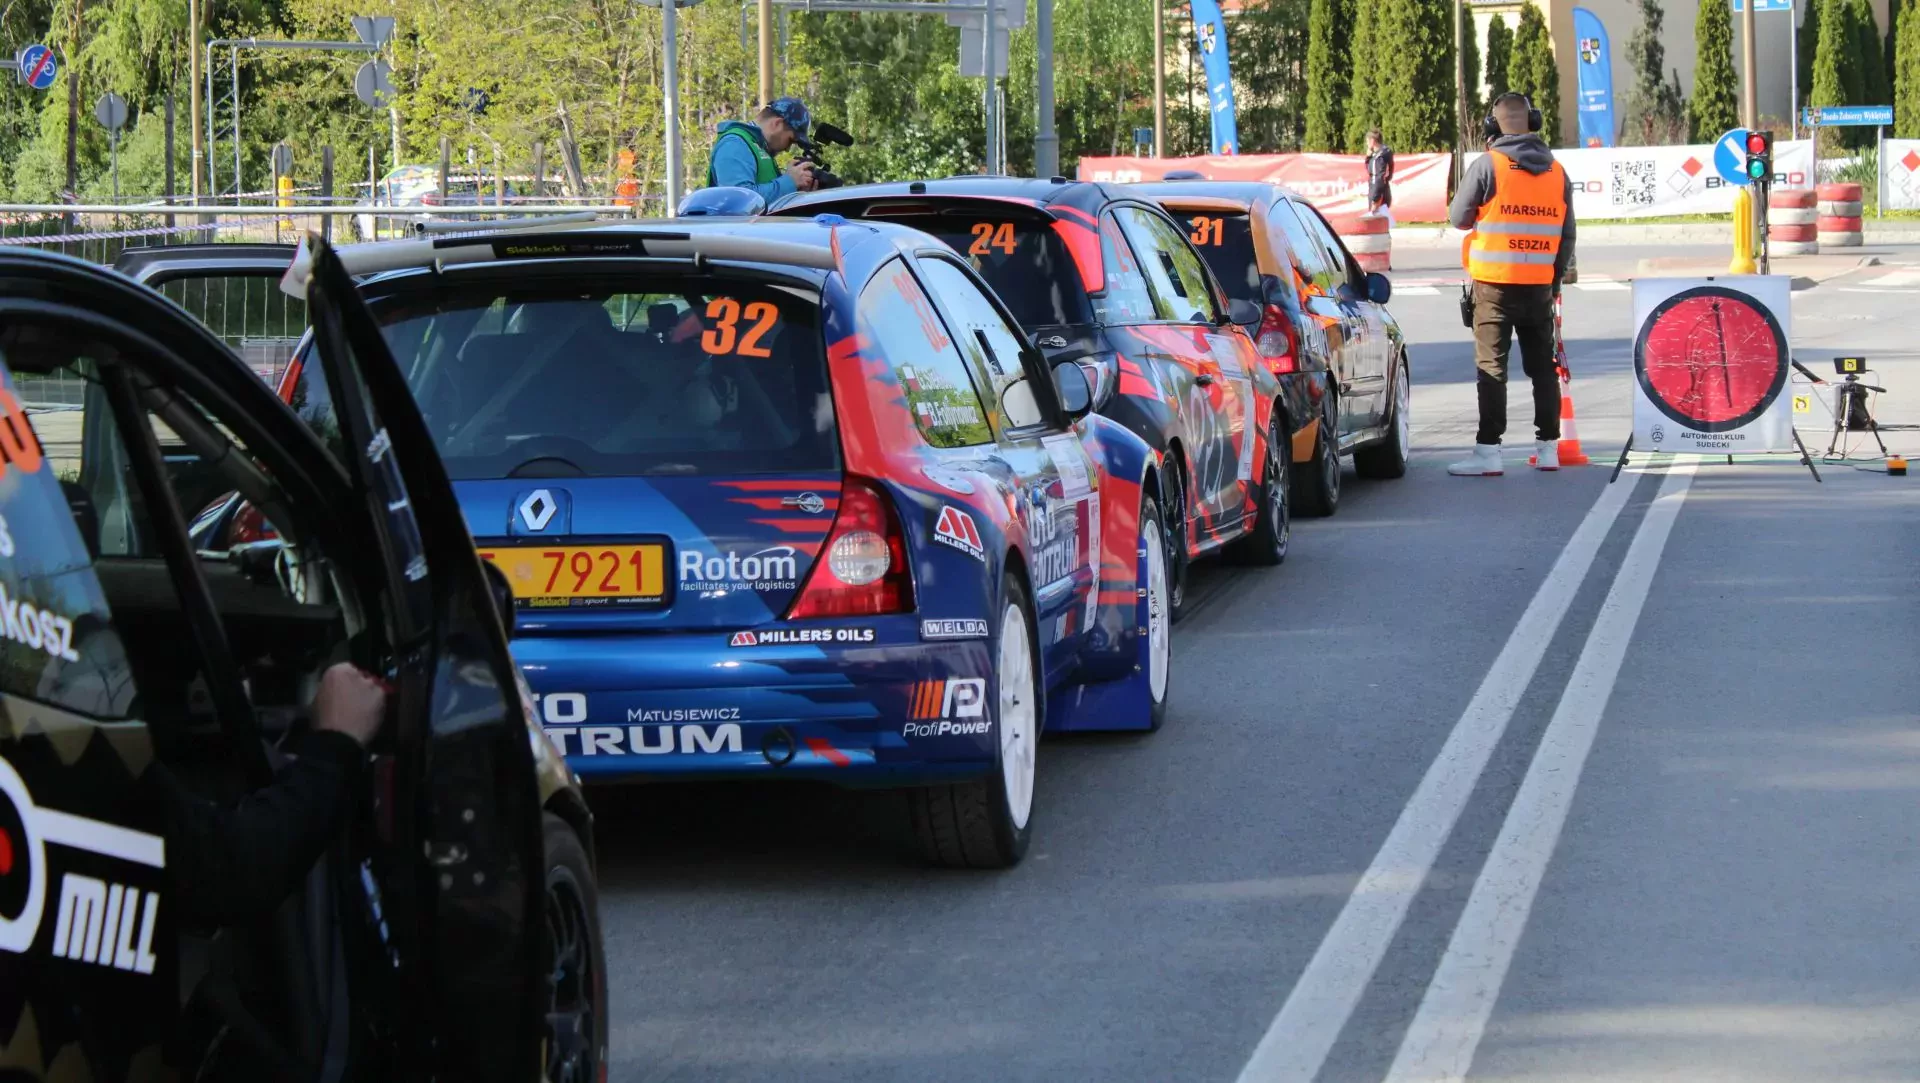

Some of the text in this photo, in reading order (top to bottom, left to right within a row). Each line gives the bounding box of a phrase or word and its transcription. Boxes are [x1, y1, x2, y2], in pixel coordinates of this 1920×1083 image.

[1500, 204, 1559, 218] MARSHAL
[968, 222, 1018, 255] 24
[1190, 216, 1224, 246] 31
[1508, 239, 1551, 252] SĘDZIA
[701, 297, 779, 358] 32
[1680, 431, 1746, 441] AUTOMOBILKLUB
[1696, 441, 1730, 449] SUDECKI
[934, 533, 986, 563] MILLERS OILS
[543, 550, 643, 593] 7921
[679, 547, 796, 581] Rotom
[680, 580, 796, 593] facilitates your logistics
[927, 621, 986, 634] WELDA
[759, 629, 874, 643] MILLERS OILS
[903, 721, 992, 737] ProfiPower
